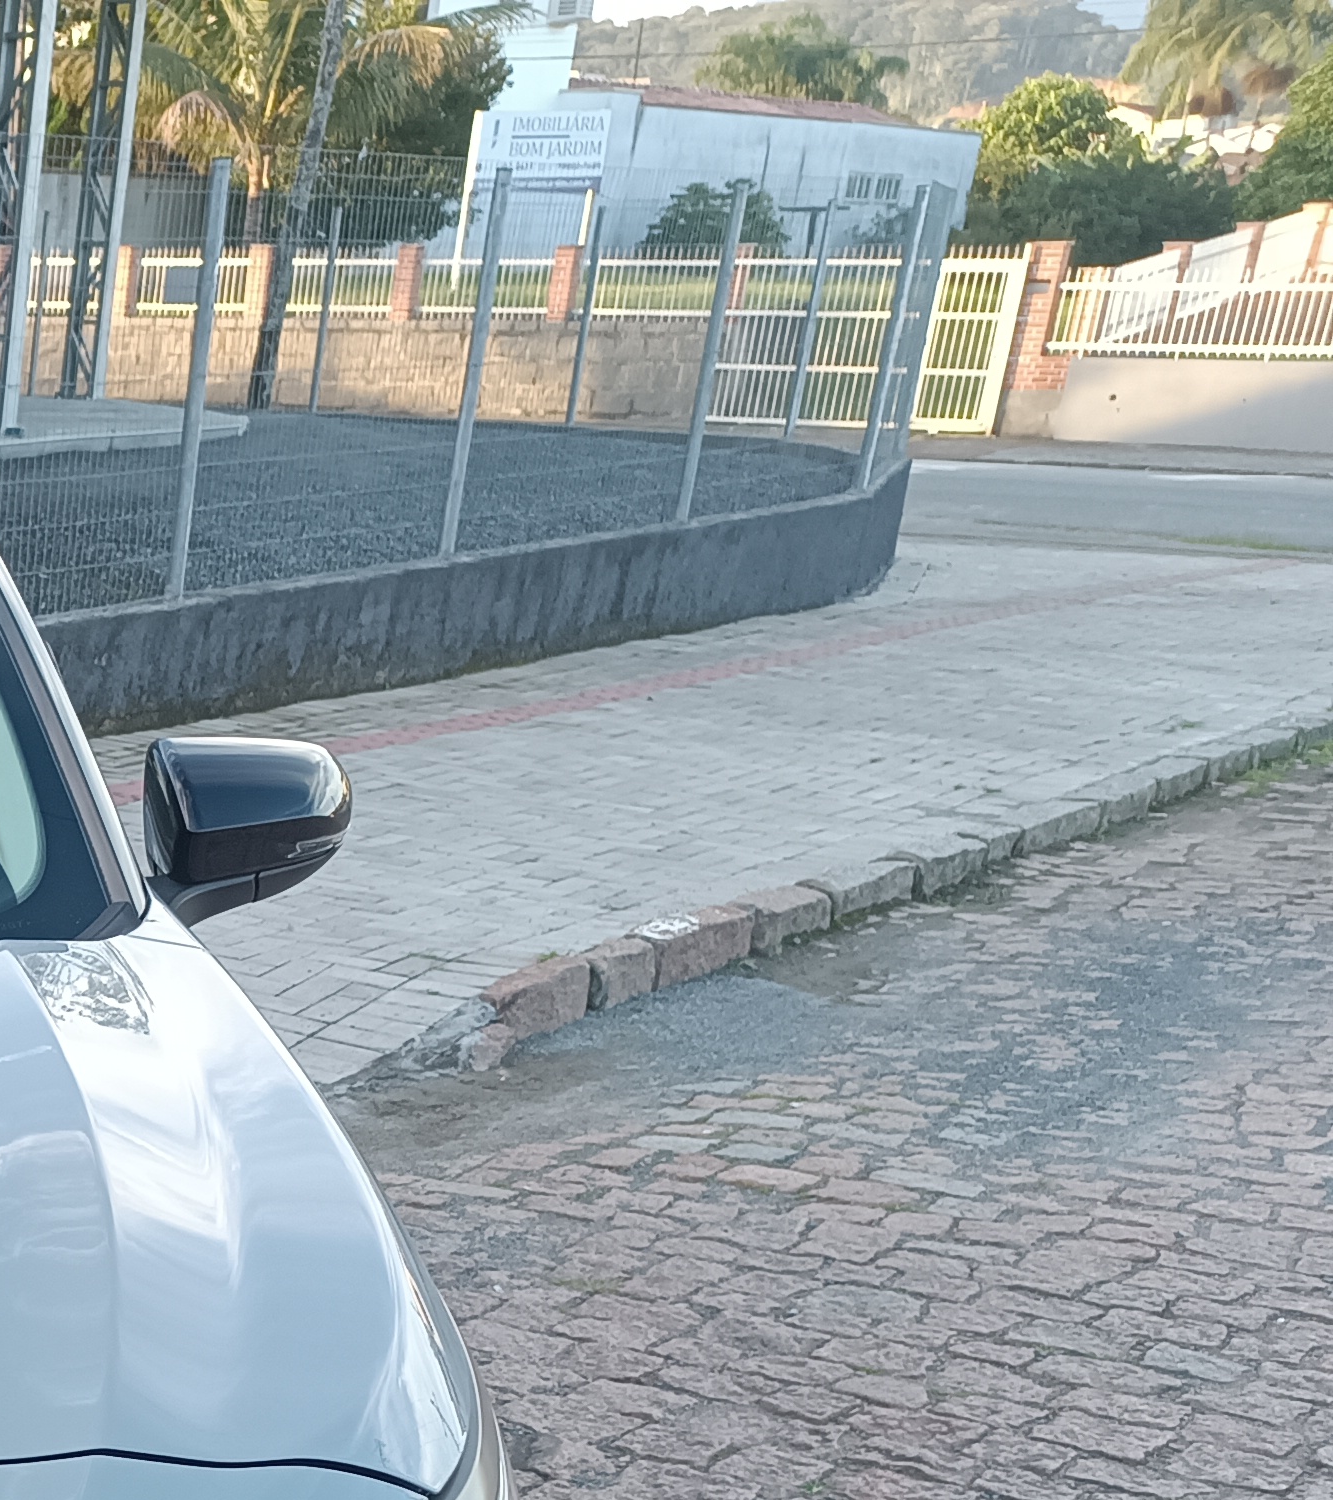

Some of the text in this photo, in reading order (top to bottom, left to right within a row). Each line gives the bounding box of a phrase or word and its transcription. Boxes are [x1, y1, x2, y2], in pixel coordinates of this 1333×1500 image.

[512, 112, 605, 132] IMOBILIÁRIA
[509, 140, 602, 159] BOM JARDIM
